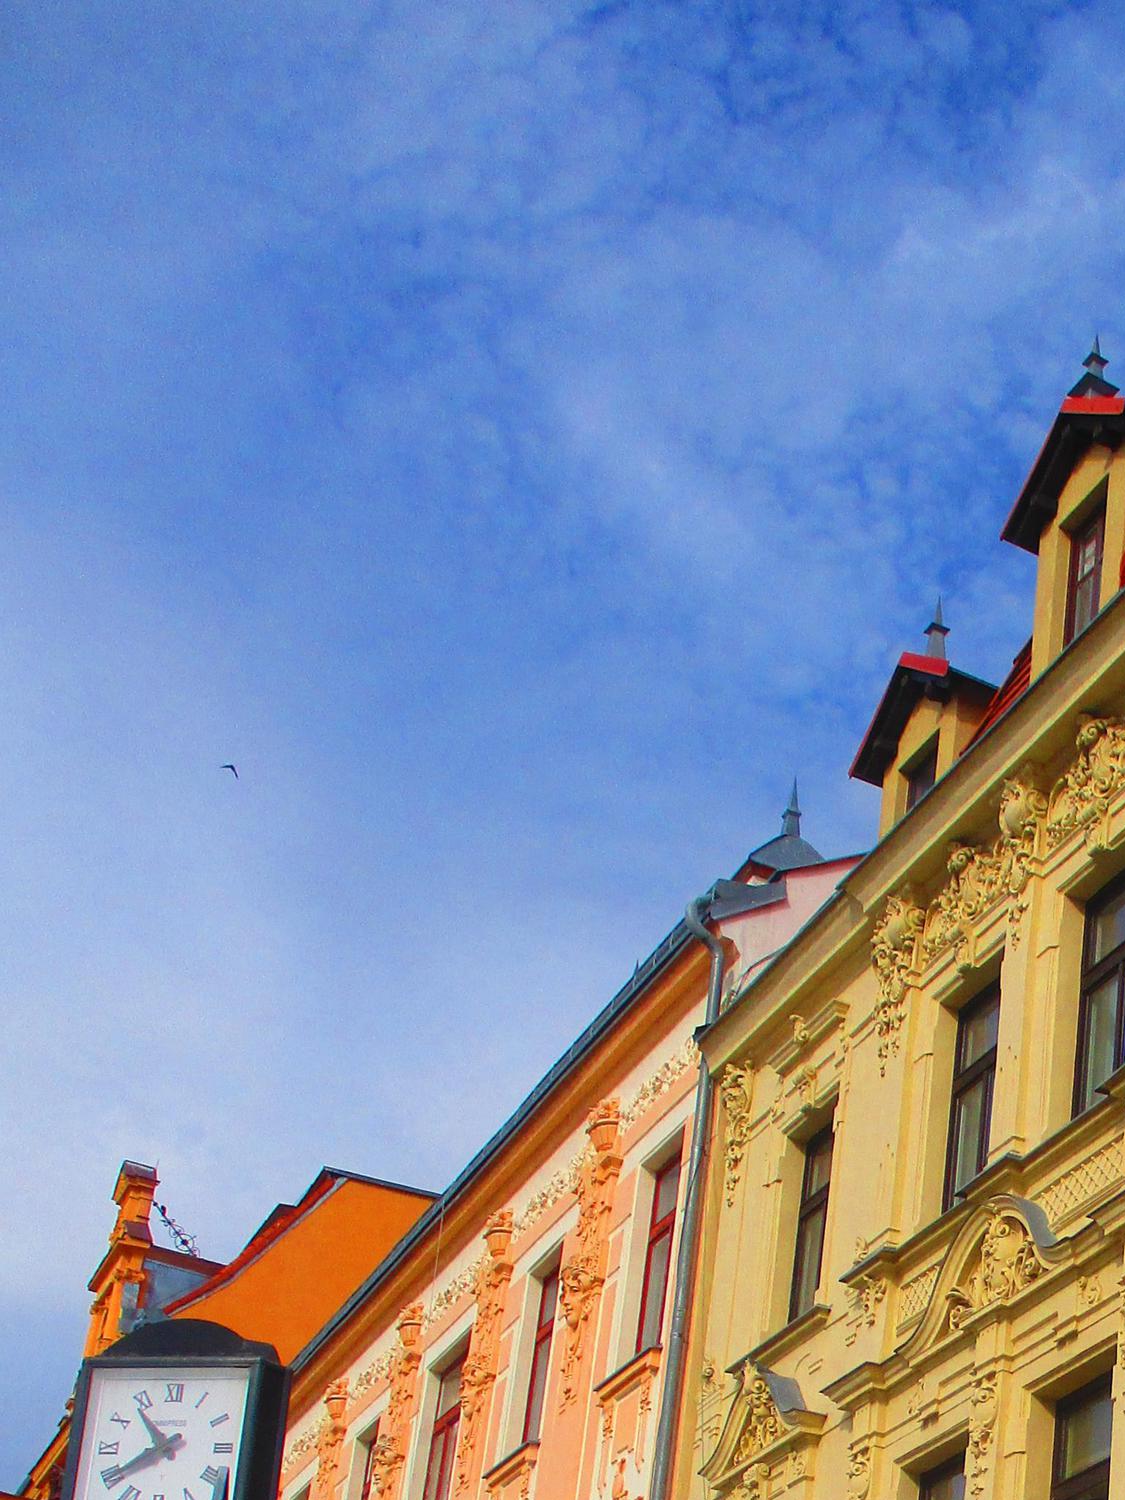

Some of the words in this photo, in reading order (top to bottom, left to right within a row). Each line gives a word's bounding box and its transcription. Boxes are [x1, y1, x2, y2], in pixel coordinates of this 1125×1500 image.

[164, 1383, 185, 1403] XII
[110, 1412, 131, 1430] X
[209, 1412, 230, 1428] II
[99, 1440, 120, 1455] IX
[213, 1442, 234, 1454] III
